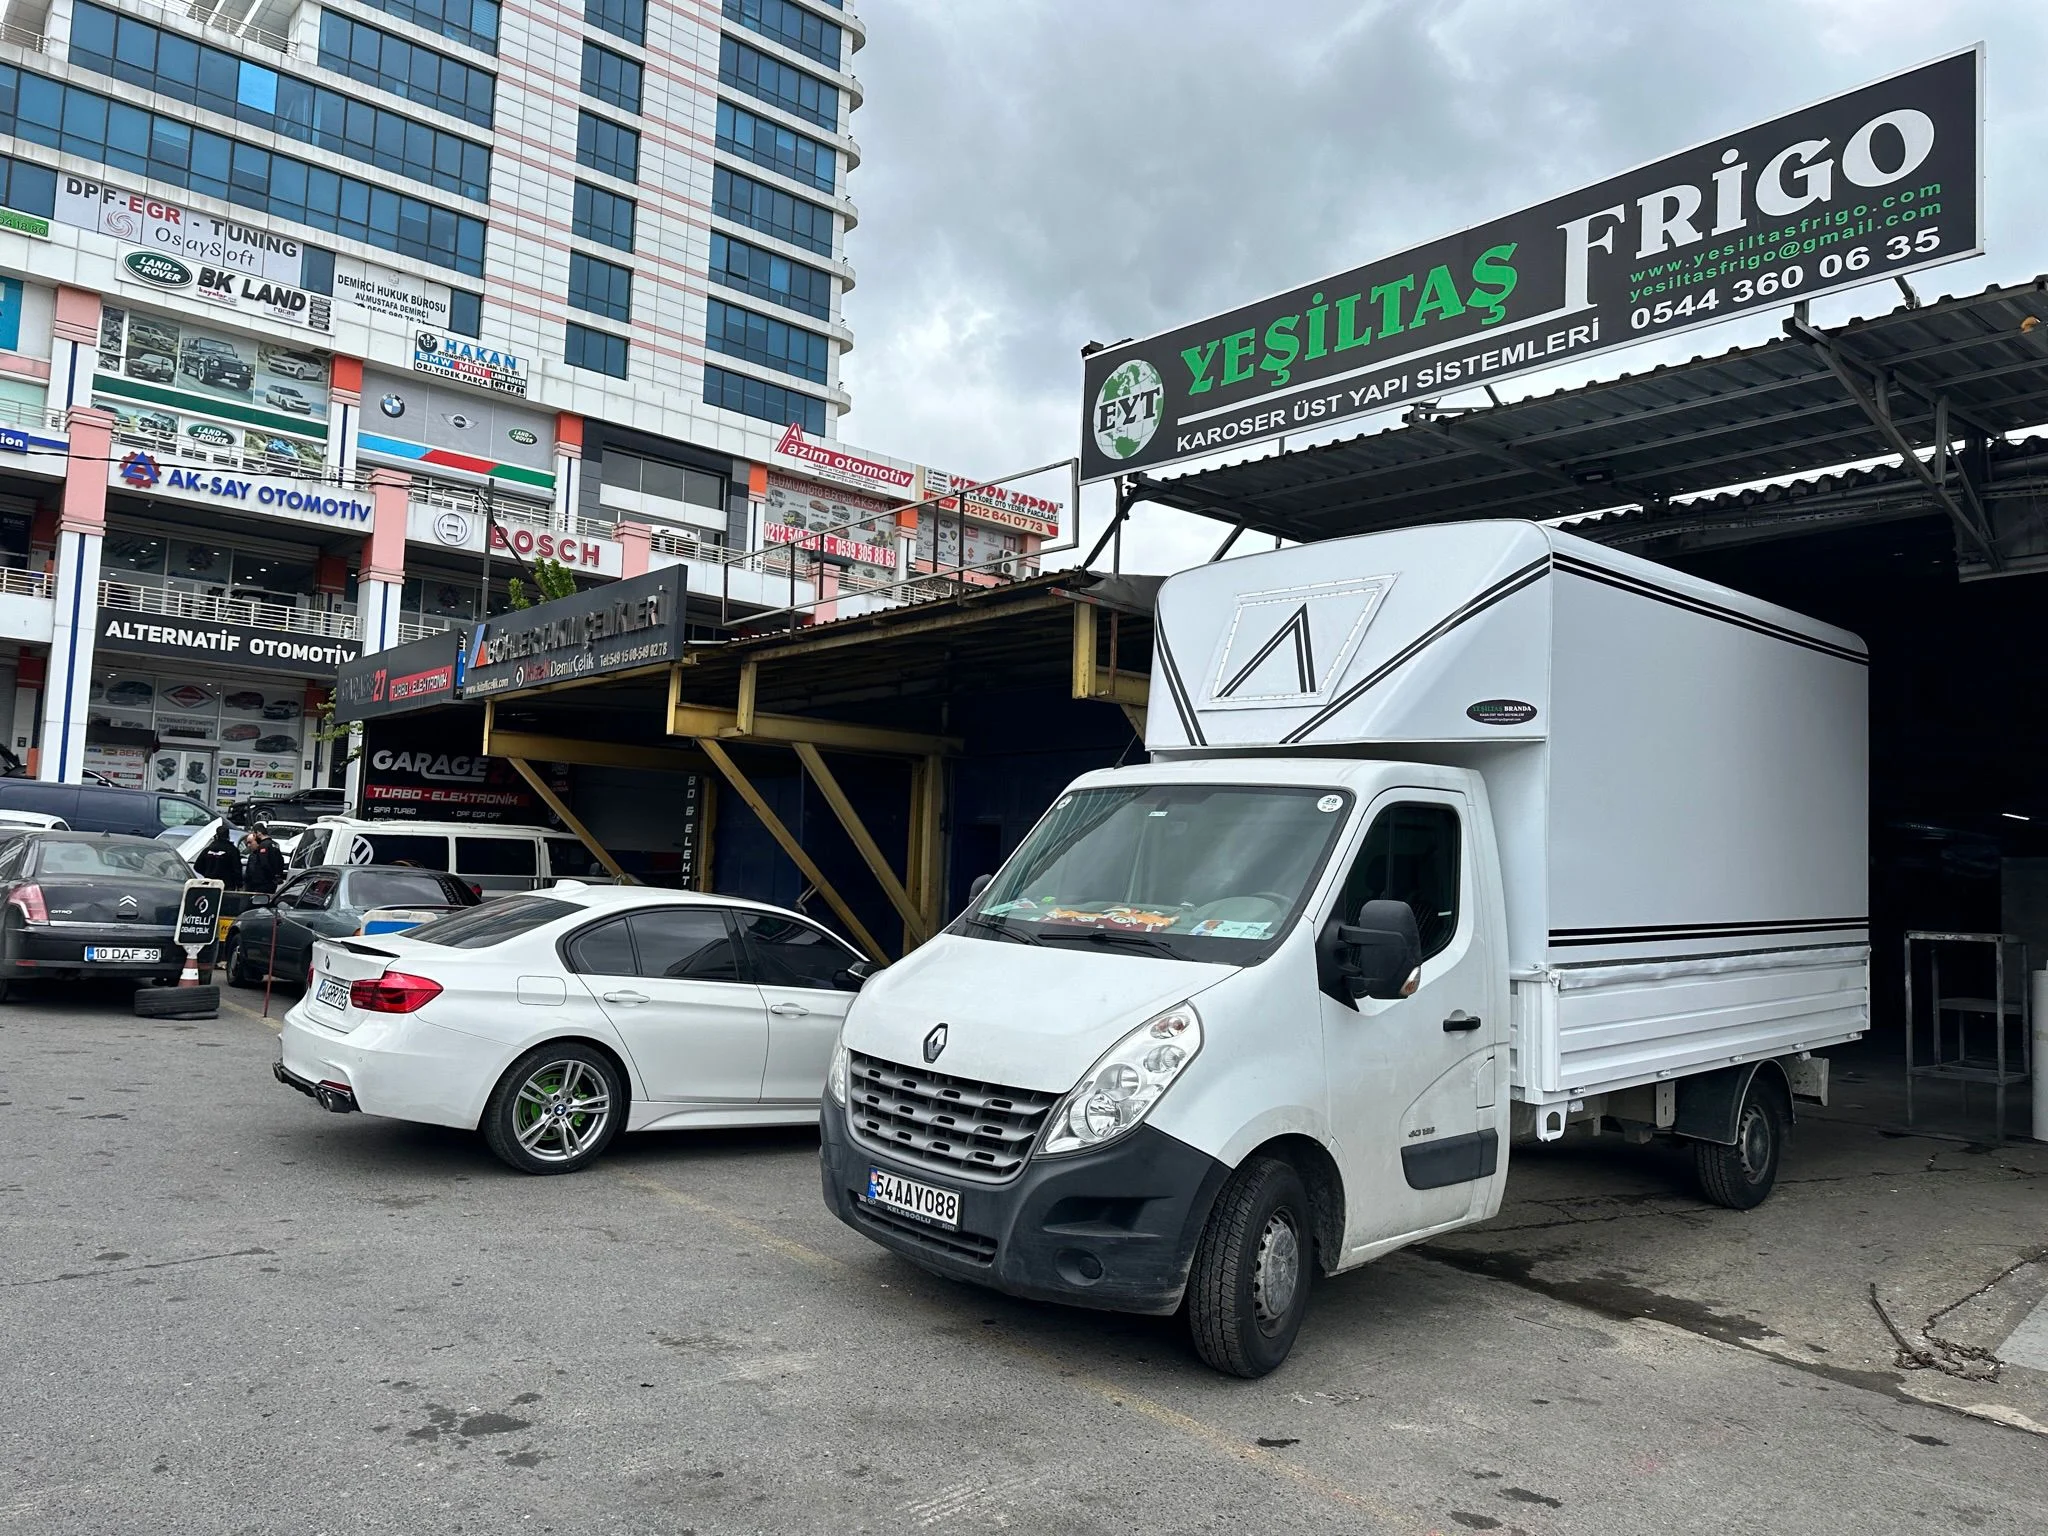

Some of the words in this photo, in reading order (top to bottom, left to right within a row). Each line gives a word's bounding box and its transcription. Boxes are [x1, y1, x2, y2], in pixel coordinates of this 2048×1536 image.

[1556, 108, 1935, 314] FRİGO
[209, 219, 297, 258] TUNING
[1629, 201, 1942, 304] yesiltasfrigo@gmail.com
[1630, 182, 1942, 284] www.yesiltasfrigo.com
[140, 257, 172, 271] LAND
[142, 265, 181, 282] ROVER
[1630, 288, 1719, 329] 0544
[1732, 265, 1804, 303] 360
[1819, 246, 1870, 279] 06
[1886, 226, 1940, 260] 35
[197, 267, 236, 294] BK
[241, 279, 306, 312] LAND
[337, 274, 375, 293] DEMİRCİ
[377, 286, 409, 303] HUKUK
[411, 295, 446, 313] BÜROSU
[400, 304, 429, 319] DEMİRCİ
[1180, 242, 1518, 396] YEŞİLTAŞ
[420, 353, 451, 367] BMW
[445, 338, 517, 370] HAKAN
[1176, 408, 1286, 454] KAROSER
[1293, 394, 1343, 431] ÜST
[1348, 373, 1408, 408] YAPI
[1416, 317, 1600, 389] SİSTEMLERİ
[1098, 385, 1163, 434] EYT
[197, 427, 221, 436] LAND
[199, 434, 228, 444] ROVER
[787, 444, 830, 464] azim
[834, 457, 910, 485] otomotiv
[167, 469, 251, 500] AK-SAY
[258, 486, 371, 522] OTOMOTİV
[1011, 492, 1059, 515] JAPON
[963, 502, 990, 518] 0212
[1013, 516, 1027, 528] 07
[1029, 520, 1043, 531] 73
[490, 523, 600, 567] BOSCH
[764, 522, 785, 542] 0212
[836, 540, 856, 559] 0539
[105, 620, 240, 651] ALTERNATİF
[249, 638, 356, 666] OTOMOTİV
[372, 750, 490, 783] GARAGE
[373, 787, 422, 800] TURBO
[431, 791, 518, 805] ELEKTRONİK
[95, 948, 107, 959] 10
[112, 948, 140, 959] DAF
[144, 949, 158, 960] 39
[876, 1174, 956, 1220] 54AAY088
